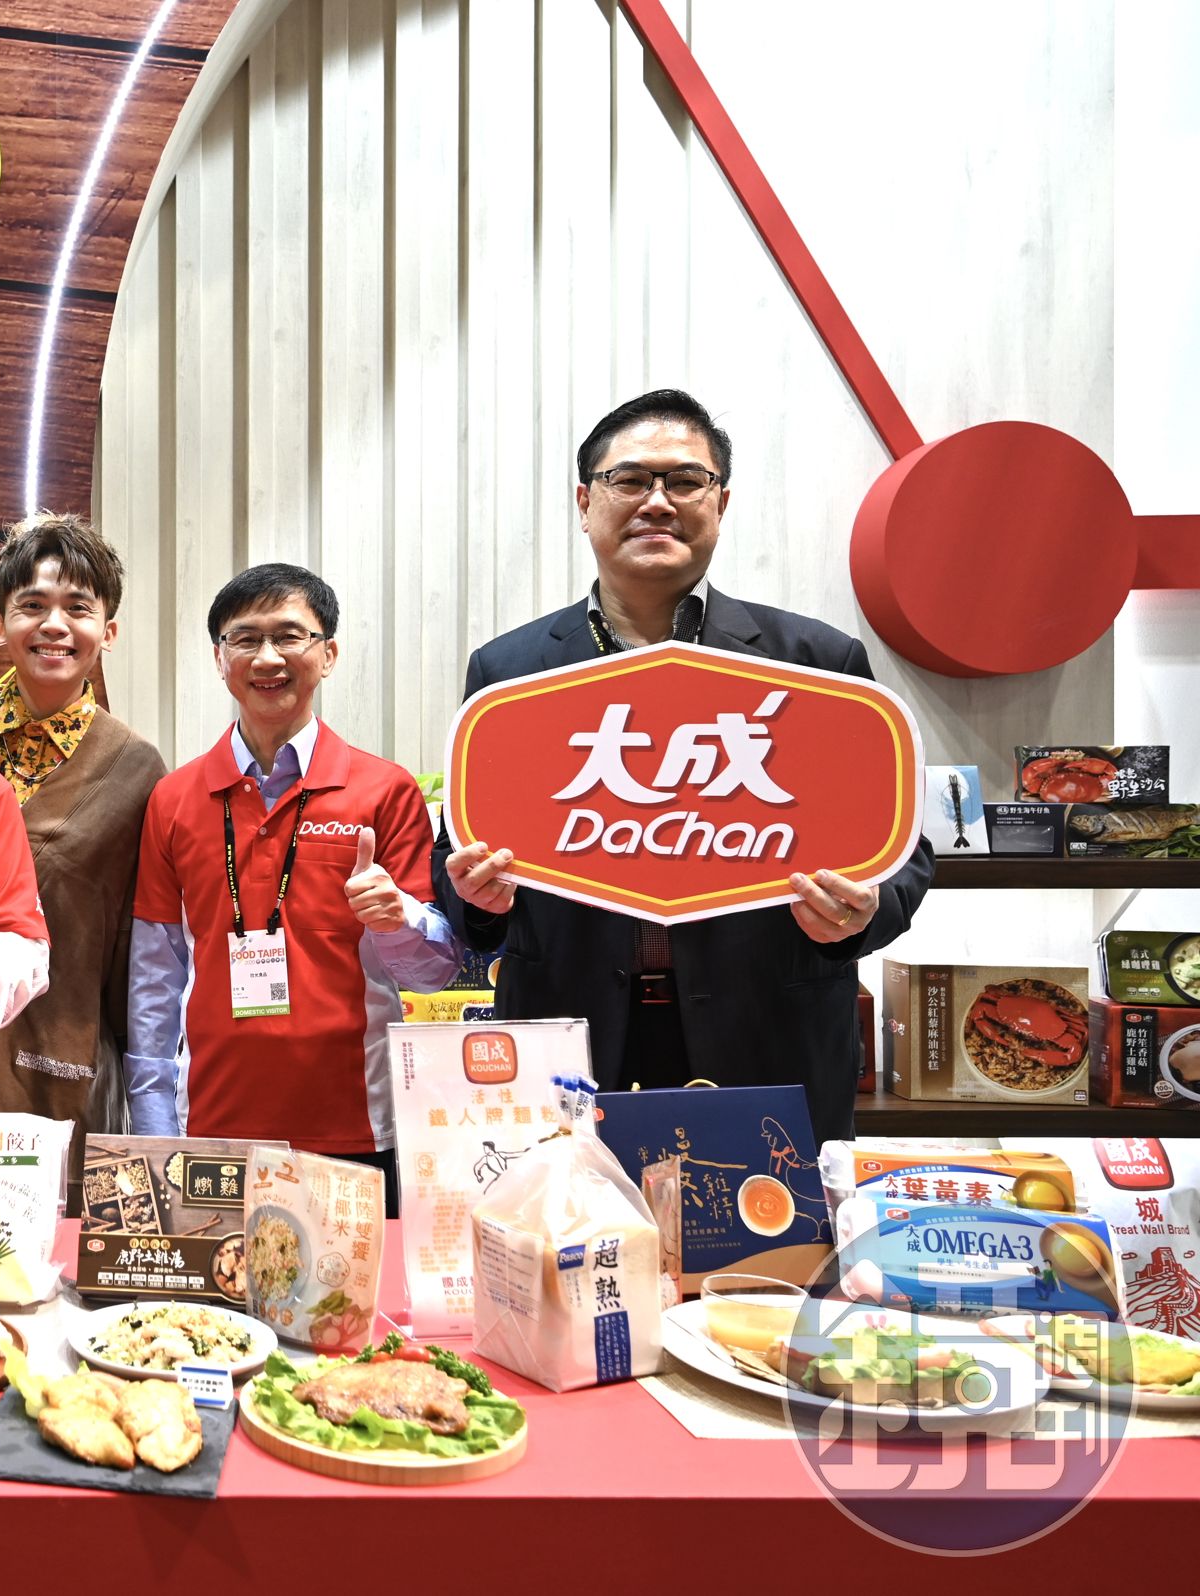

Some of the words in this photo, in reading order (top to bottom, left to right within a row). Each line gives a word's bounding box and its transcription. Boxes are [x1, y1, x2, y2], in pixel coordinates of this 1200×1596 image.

[551, 690, 795, 804] 大成
[555, 808, 795, 859] DaChan
[231, 951, 256, 960] FOOD
[257, 948, 285, 958] TAIPEI
[471, 1042, 509, 1063] 國成
[470, 1064, 512, 1073] KOUCHAN
[470, 1088, 514, 1104] 活性
[1109, 1165, 1164, 1175] KOUCHAN
[1136, 1197, 1164, 1222] 城
[905, 1225, 921, 1252] 大成
[1140, 1225, 1165, 1235] Wall
[1167, 1224, 1190, 1235] Brand
[923, 1228, 1034, 1261] OMEGA-3
[559, 1252, 584, 1263] Pasco
[593, 1238, 621, 1312] 超熟
